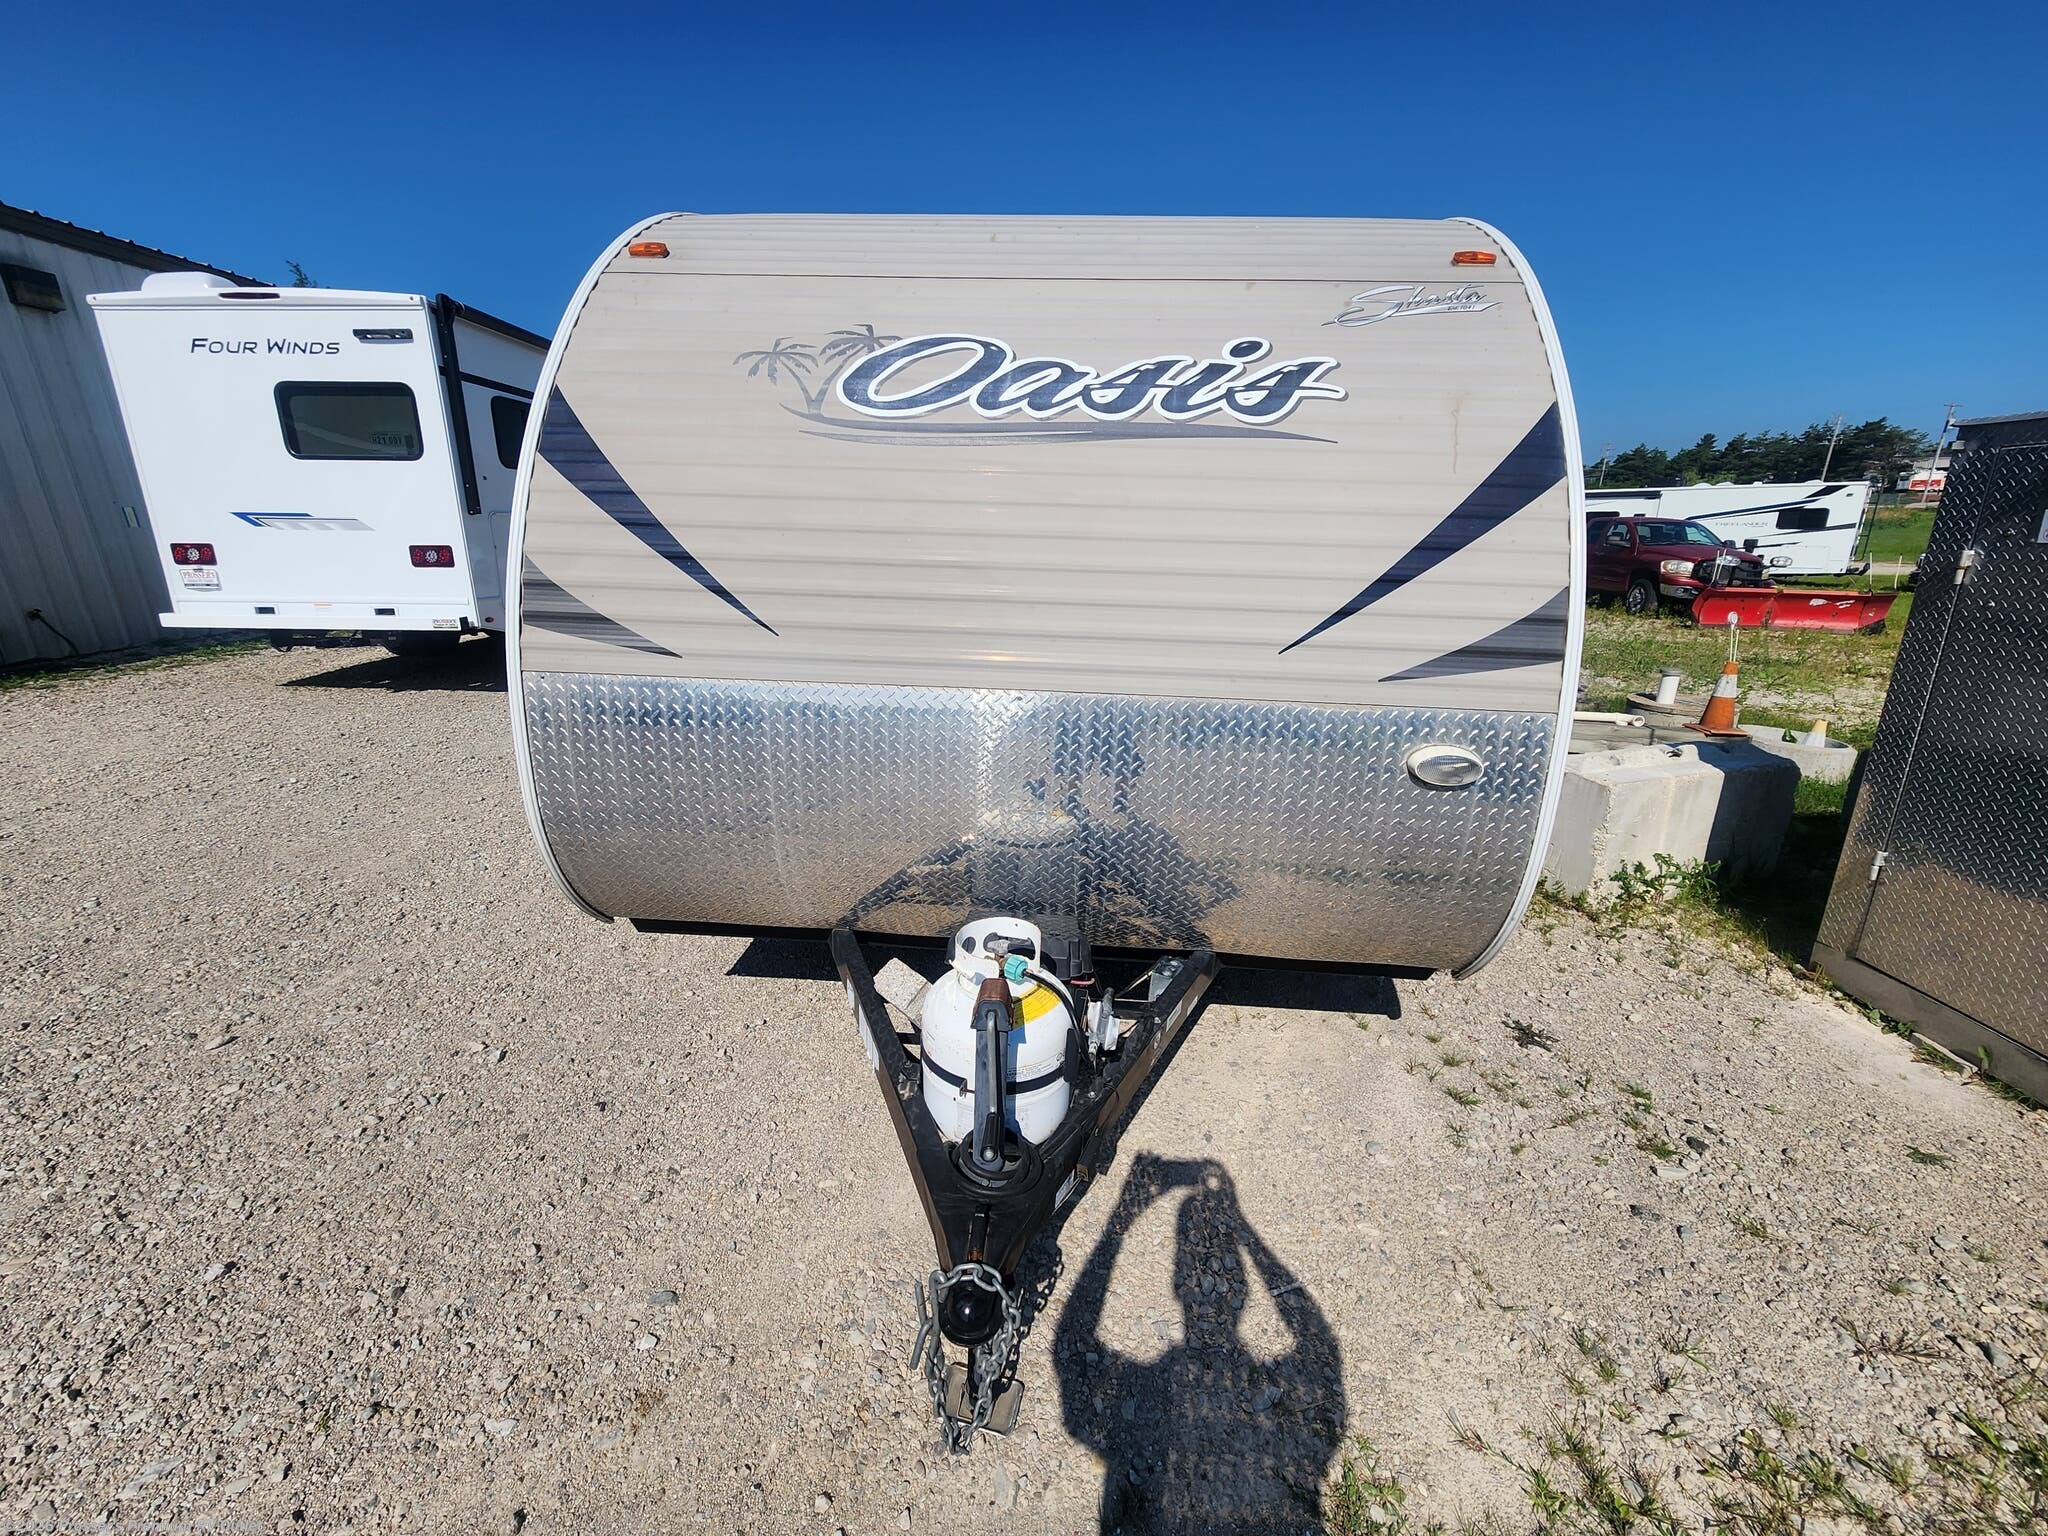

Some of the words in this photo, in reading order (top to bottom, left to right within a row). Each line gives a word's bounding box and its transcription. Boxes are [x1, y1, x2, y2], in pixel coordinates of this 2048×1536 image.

[1321, 284, 1490, 327] Shasta
[190, 337, 258, 354] FOUR
[266, 337, 341, 355] WINDS
[836, 333, 1347, 426] Oasis
